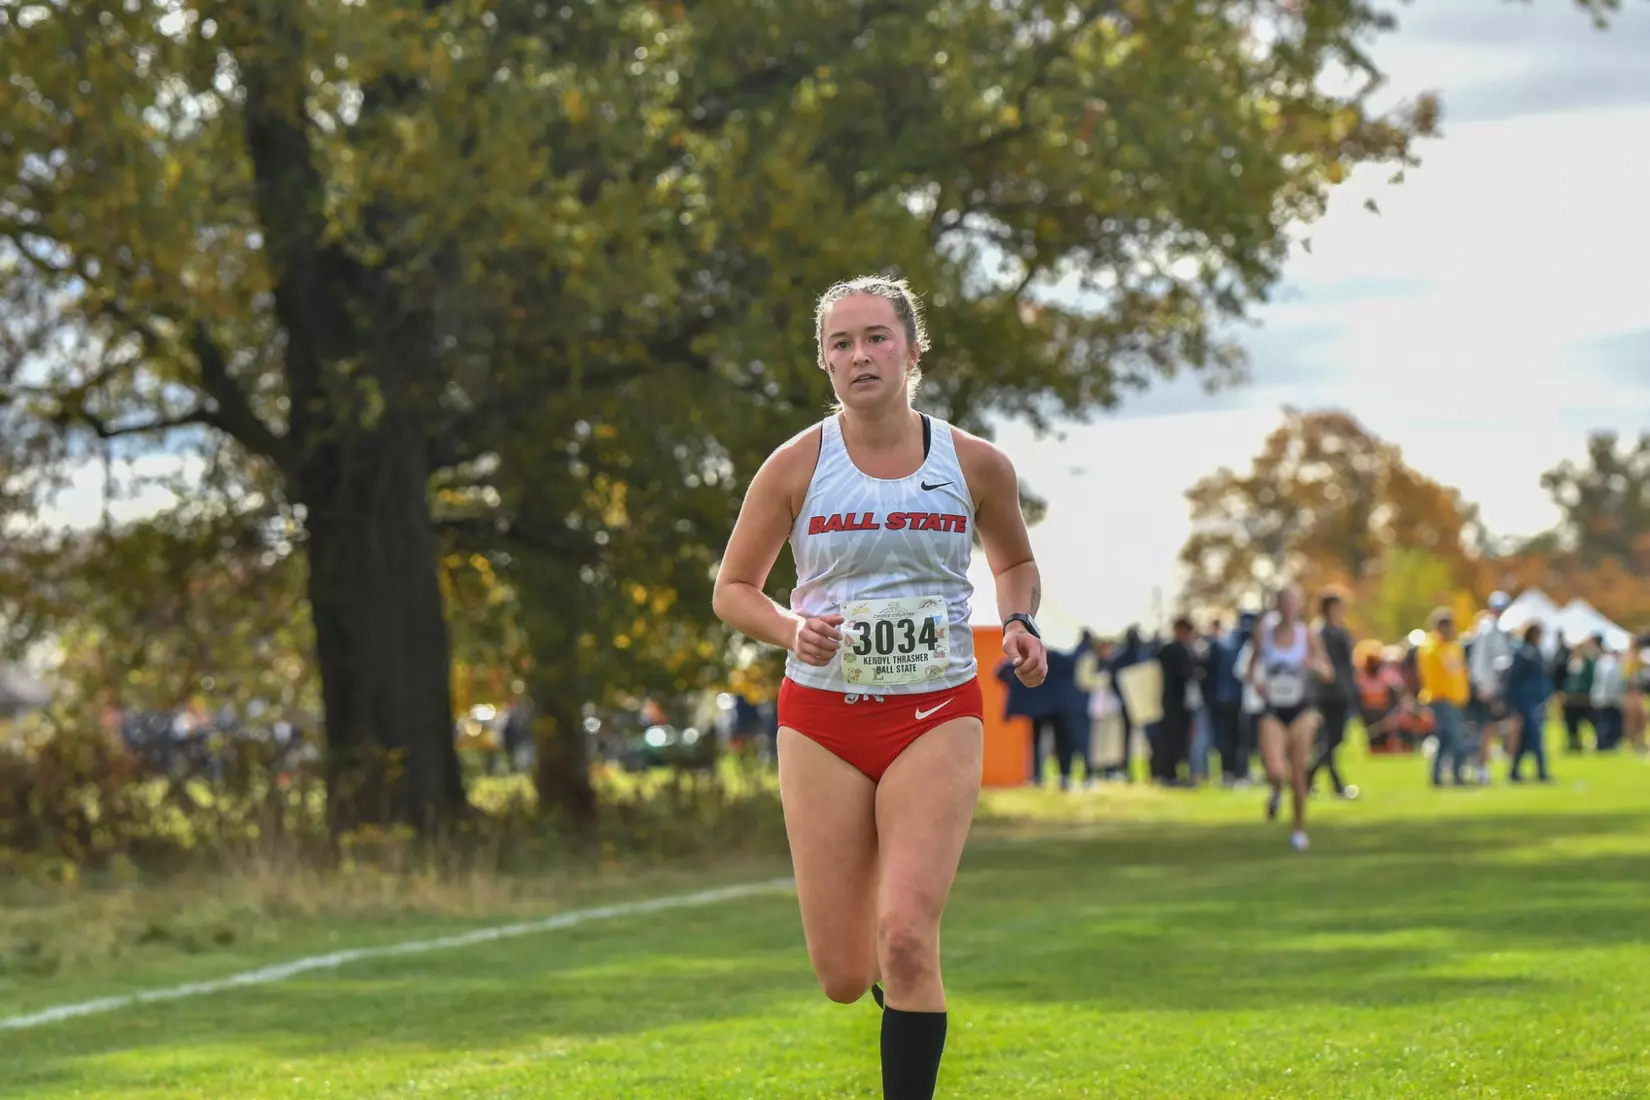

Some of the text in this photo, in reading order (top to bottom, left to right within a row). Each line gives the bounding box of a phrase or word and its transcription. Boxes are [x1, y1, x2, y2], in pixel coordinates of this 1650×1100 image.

[808, 511, 967, 535] BALL STATE
[853, 617, 938, 655] 3034
[863, 653, 929, 665] KENDYL THRASHER
[876, 665, 894, 674] BALL
[896, 664, 917, 673] STATE
